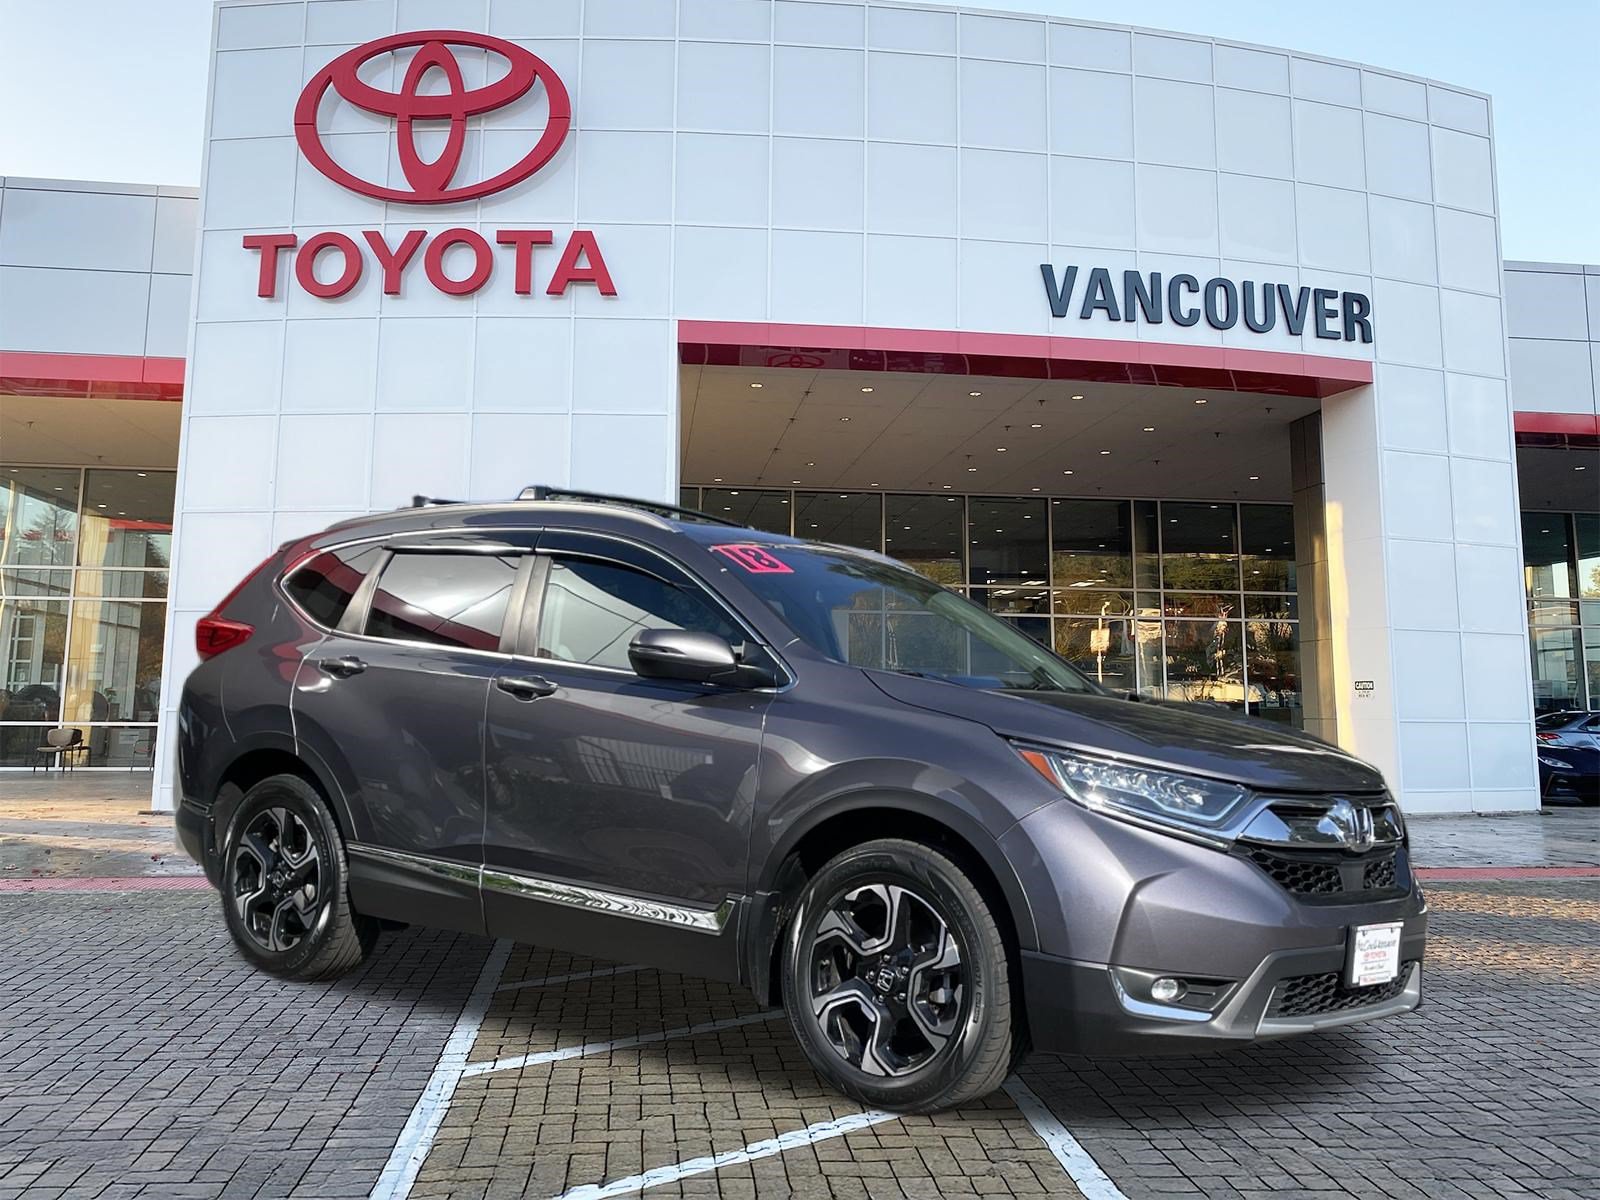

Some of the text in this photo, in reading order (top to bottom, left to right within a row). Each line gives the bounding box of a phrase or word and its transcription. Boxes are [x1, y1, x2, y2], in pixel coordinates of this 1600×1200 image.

[243, 228, 617, 298] TOYOTA
[1040, 264, 1373, 343] VANCOUVER
[721, 547, 779, 569] 18
